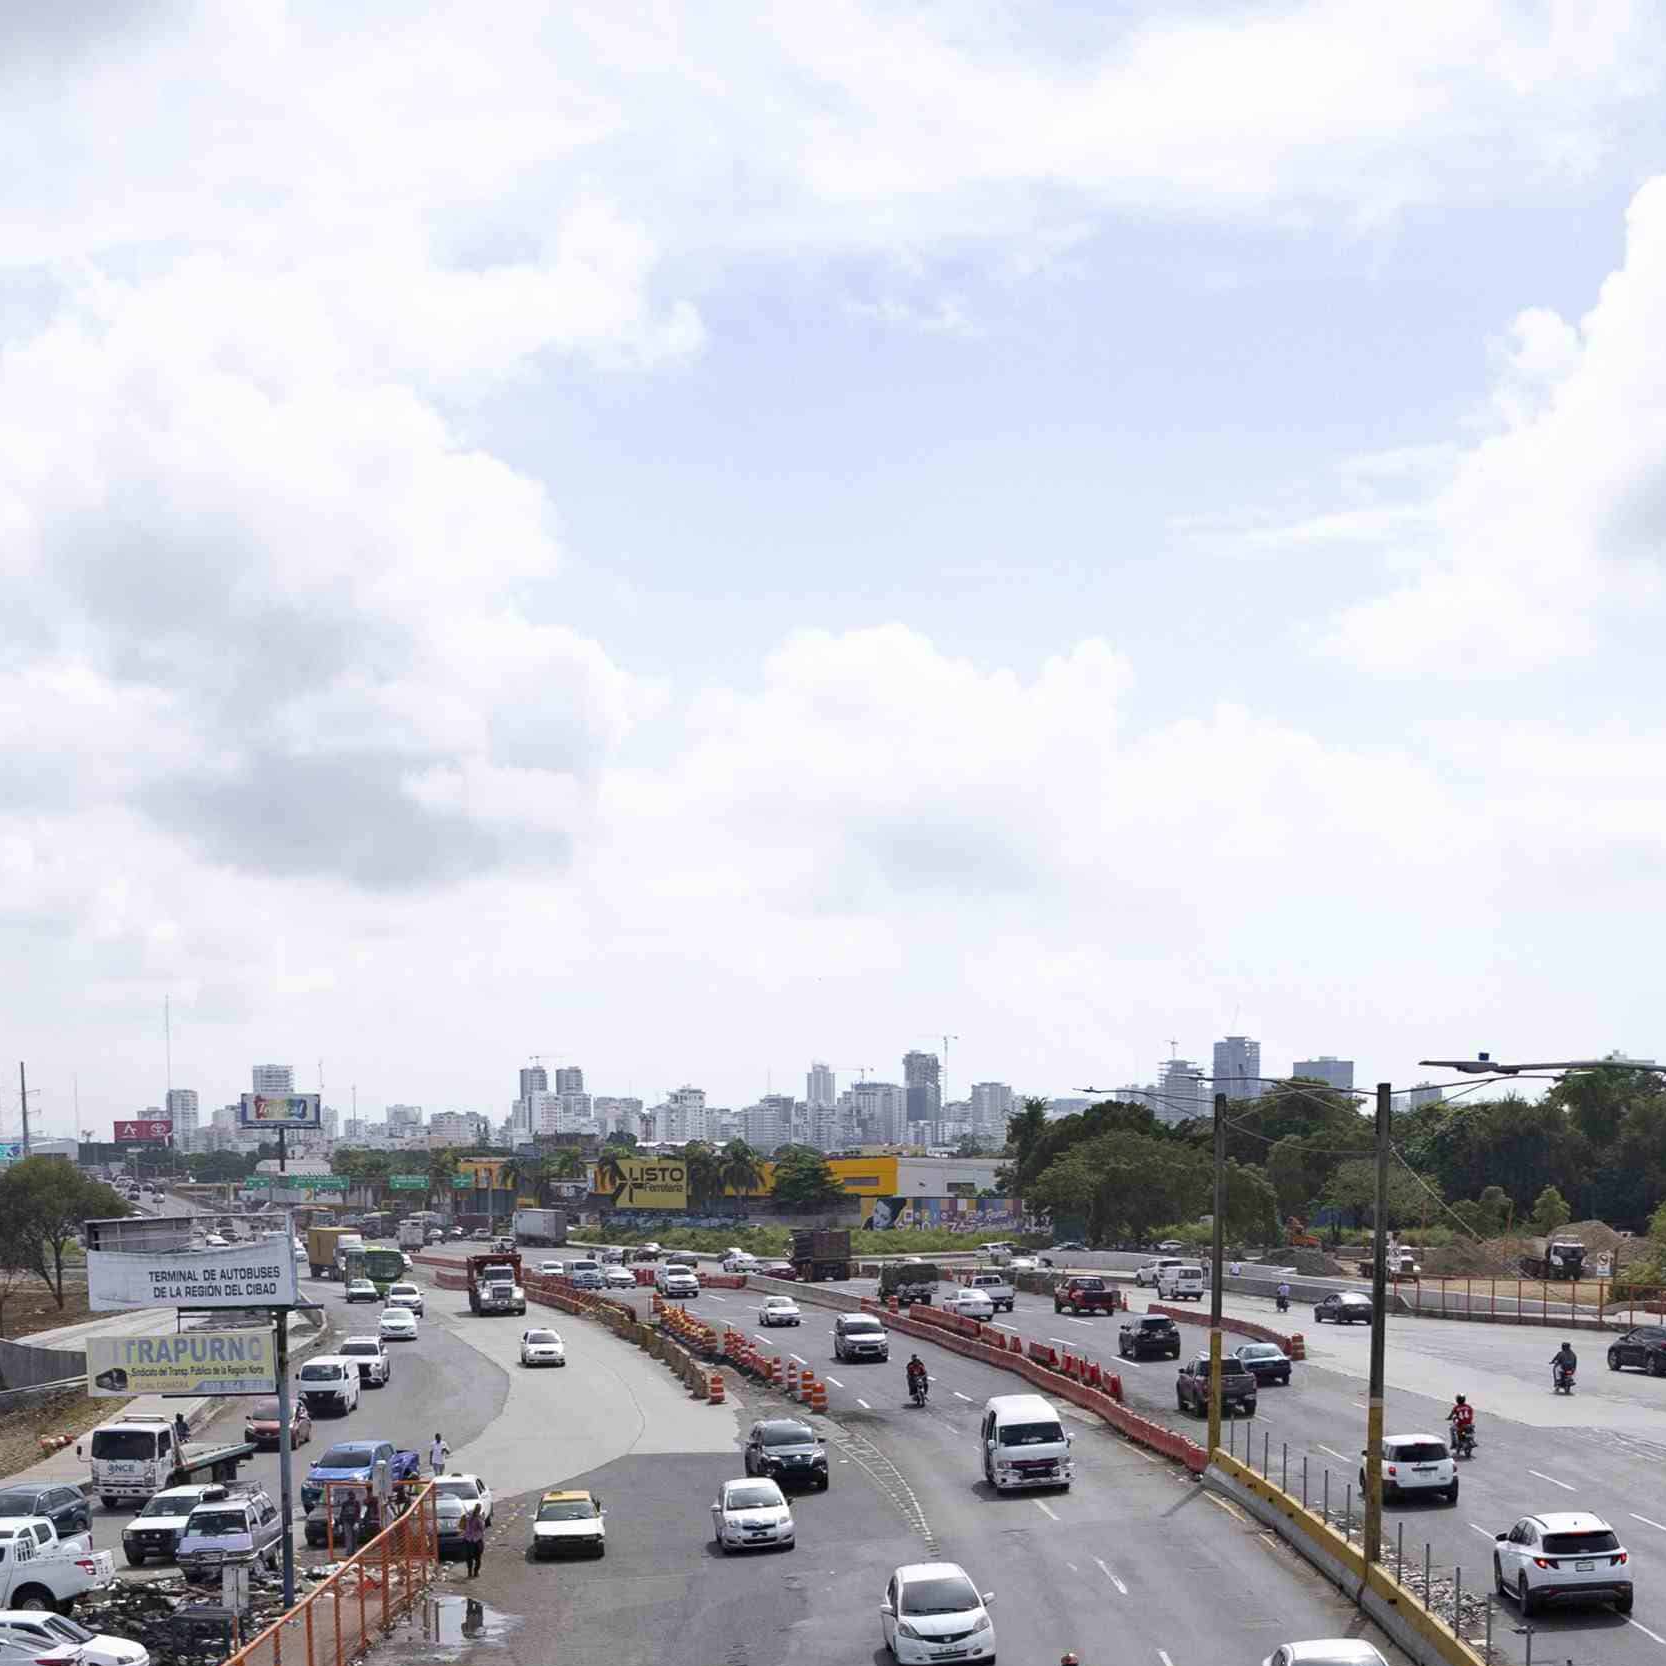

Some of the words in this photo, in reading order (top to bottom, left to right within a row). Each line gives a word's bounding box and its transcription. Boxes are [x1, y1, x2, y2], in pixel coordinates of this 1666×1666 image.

[629, 1167, 684, 1181] LISTO
[148, 1269, 198, 1283] TERMINAL
[203, 1269, 216, 1280] DE
[219, 1265, 281, 1280] AUTOBUSES
[153, 1286, 166, 1298] DE
[169, 1285, 182, 1298] LA
[224, 1284, 244, 1296] DEL
[246, 1282, 277, 1295] CIBAO
